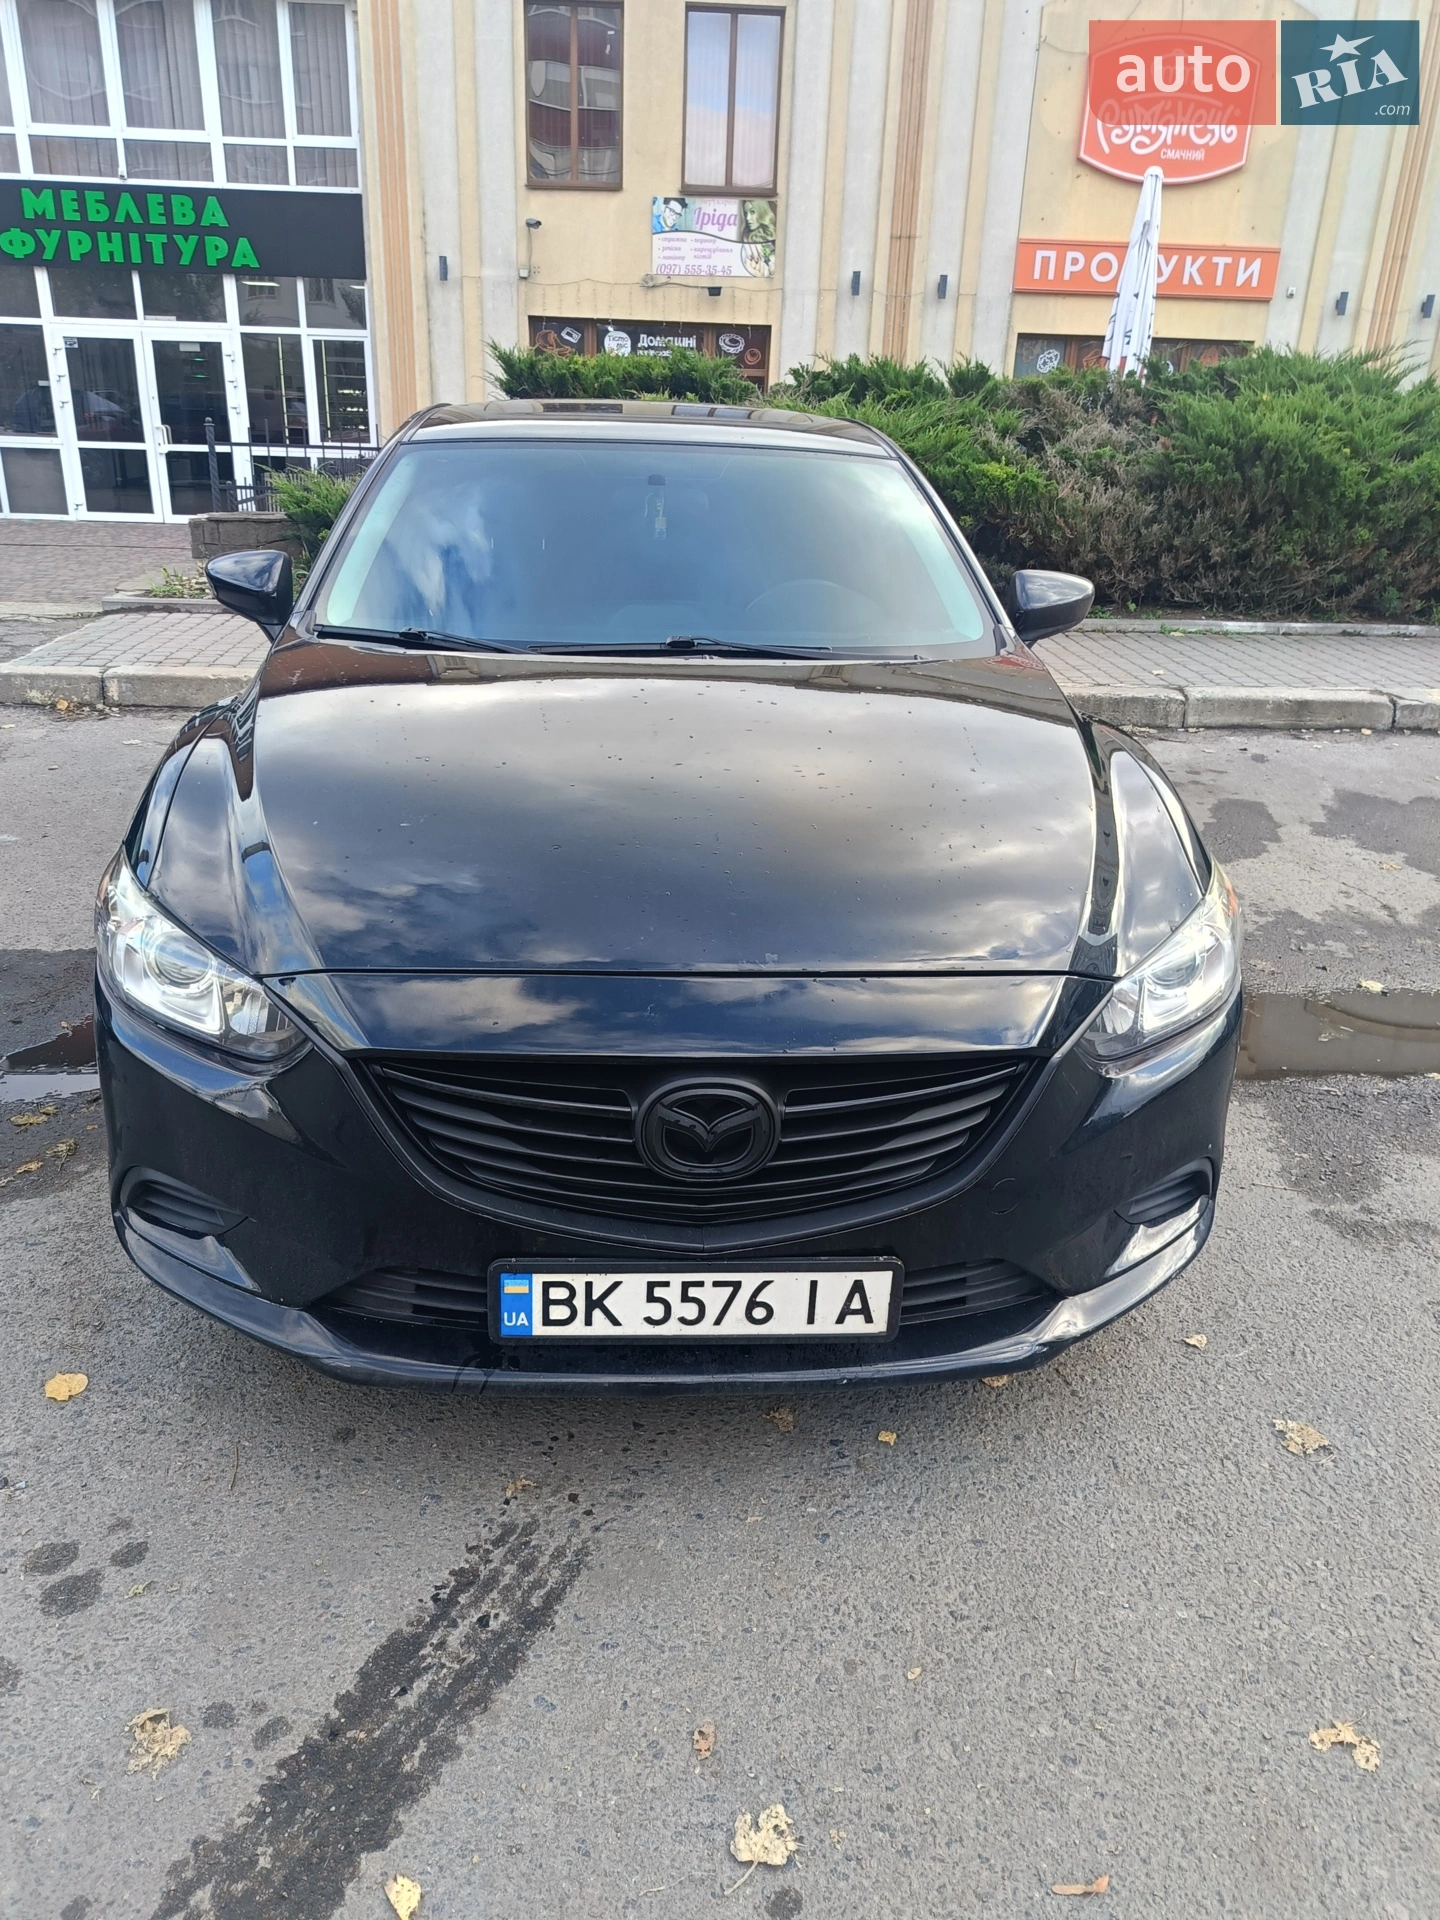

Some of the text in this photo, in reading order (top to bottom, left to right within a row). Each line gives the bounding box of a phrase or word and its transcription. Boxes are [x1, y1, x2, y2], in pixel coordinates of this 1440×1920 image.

[1160, 148, 1205, 161] СМАЧНИЙ
[20, 187, 230, 228] МЕБЛЕВА
[0, 227, 261, 268] ФУРНІТУРА
[656, 263, 732, 276] (097) 555-35-45
[1032, 250, 1262, 288] ПРОУКТИ
[503, 1312, 529, 1327] UA
[541, 1280, 623, 1327] BK
[643, 1279, 775, 1327] 5576
